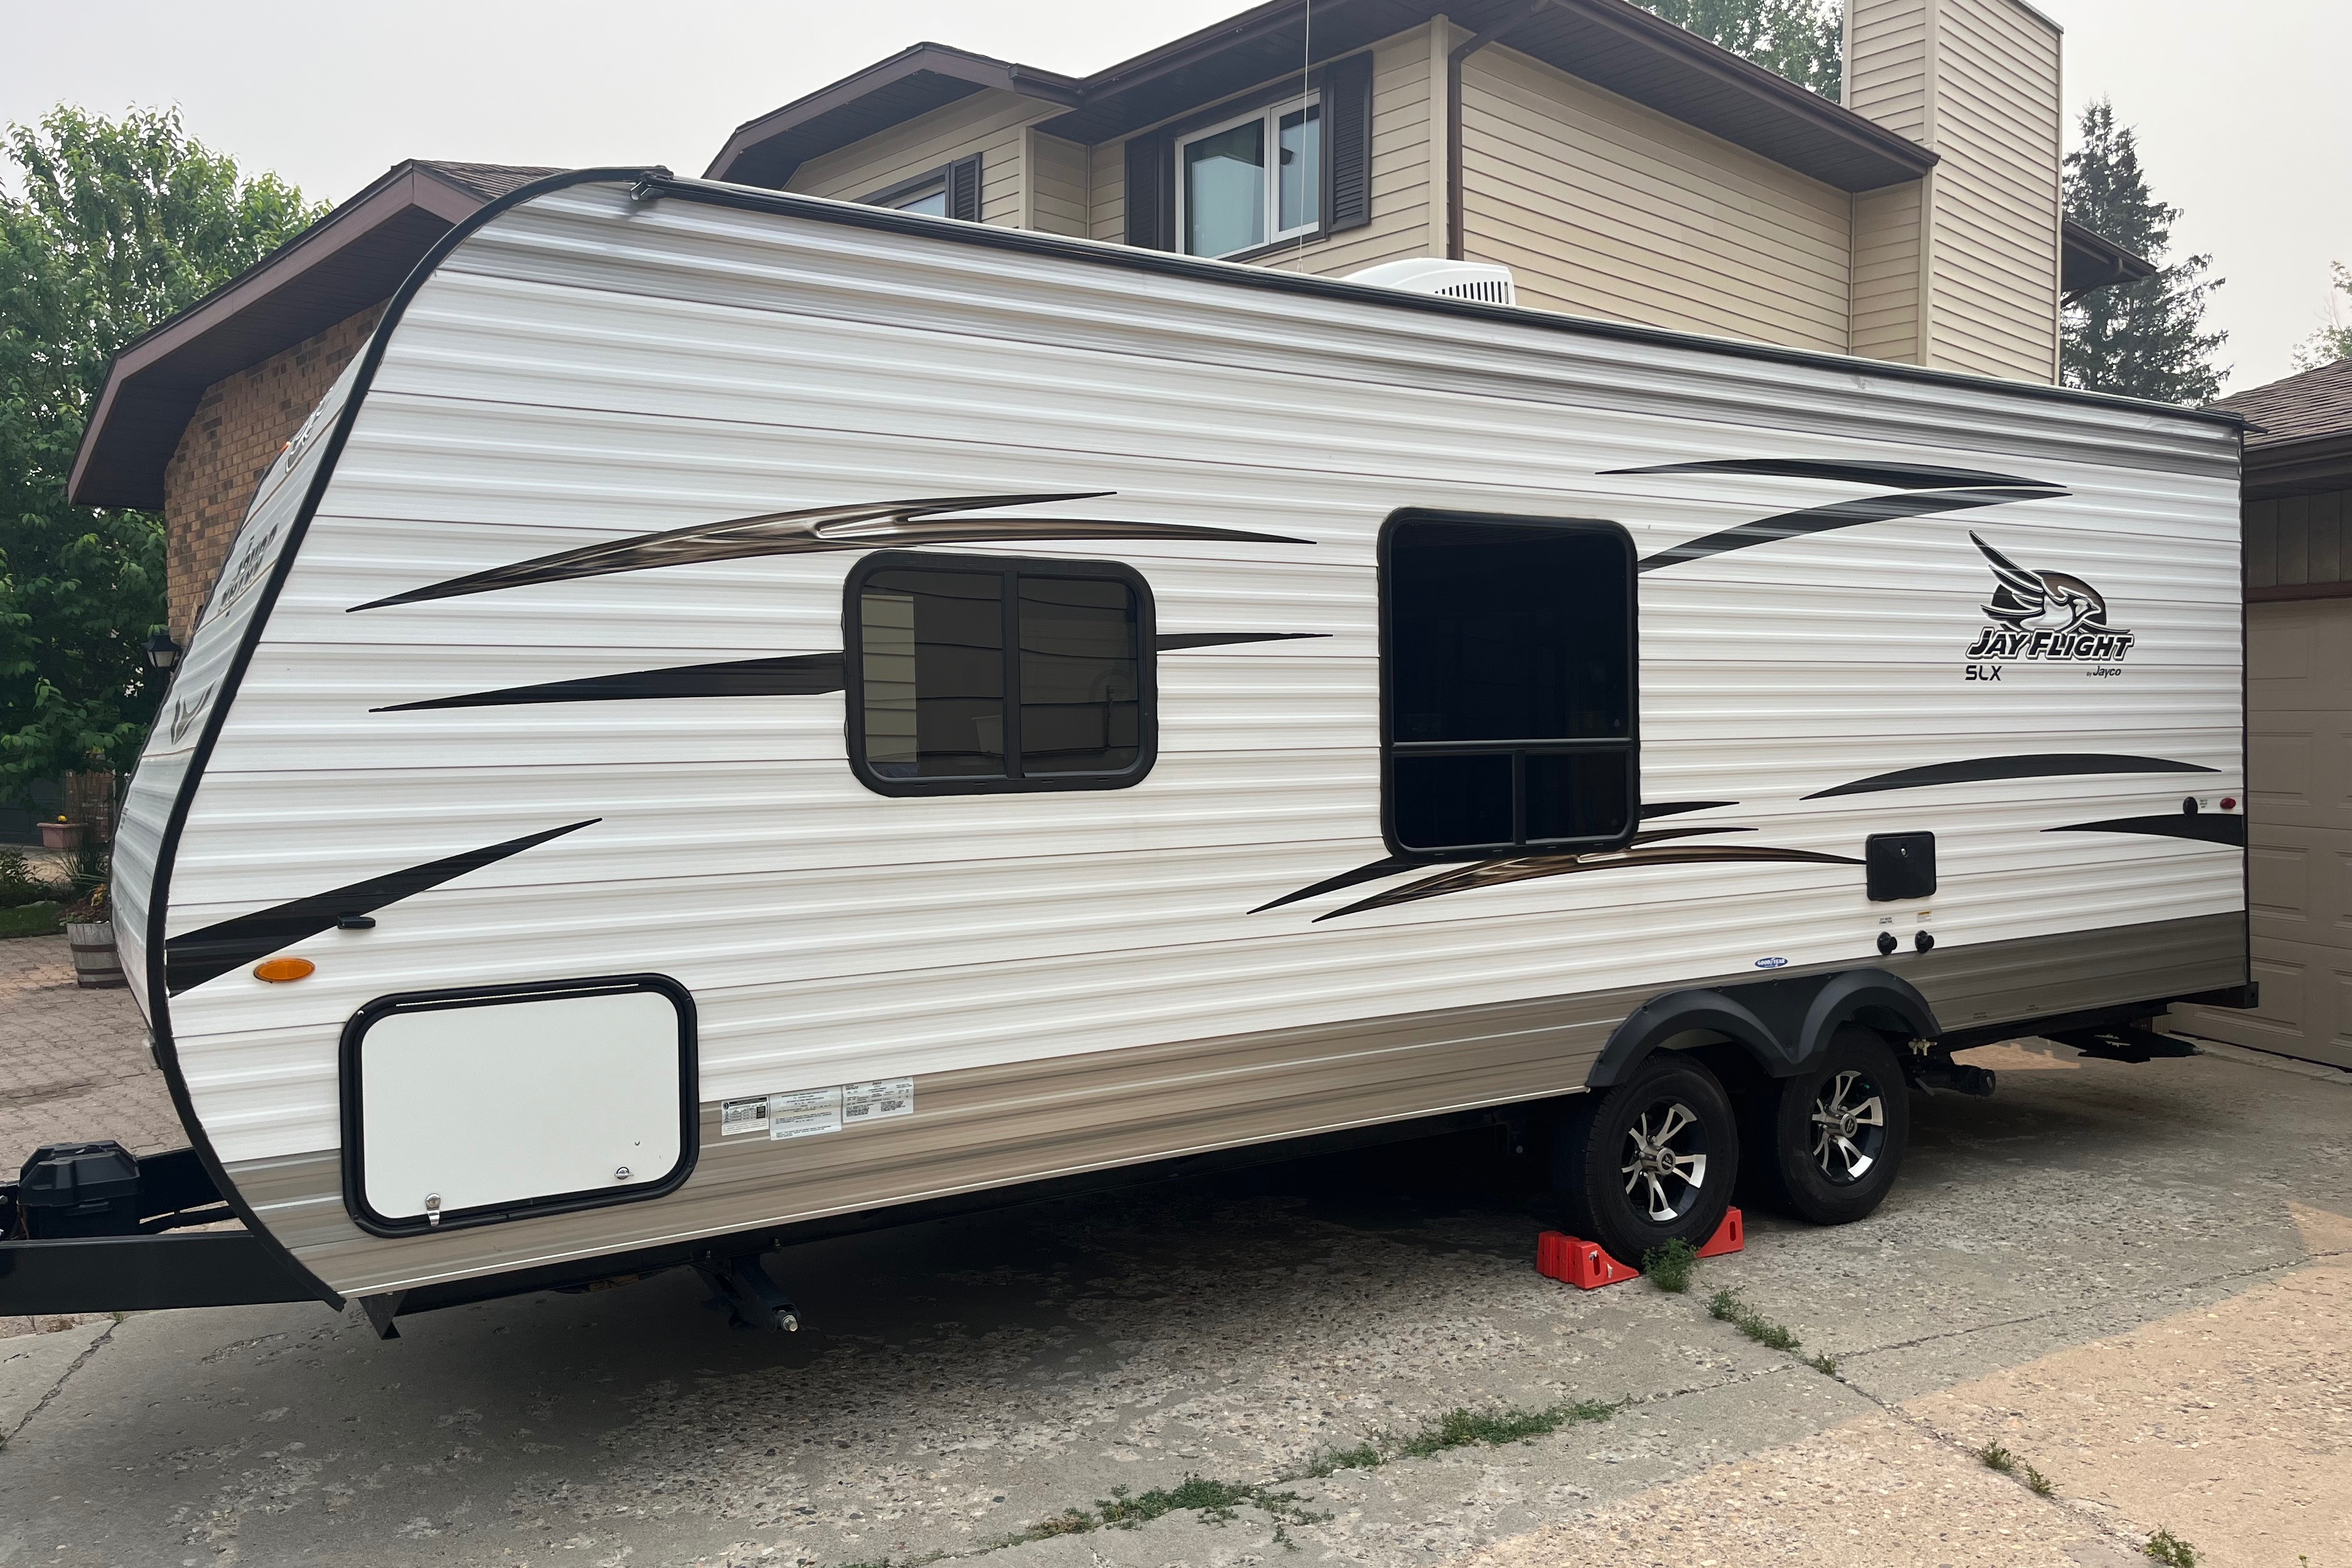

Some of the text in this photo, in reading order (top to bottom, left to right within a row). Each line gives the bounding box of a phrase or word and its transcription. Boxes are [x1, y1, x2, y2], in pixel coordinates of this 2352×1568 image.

[1966, 627, 2134, 660] JAY FLIGHT
[1965, 665, 2002, 681] SLX
[2093, 666, 2122, 678] Jayco
